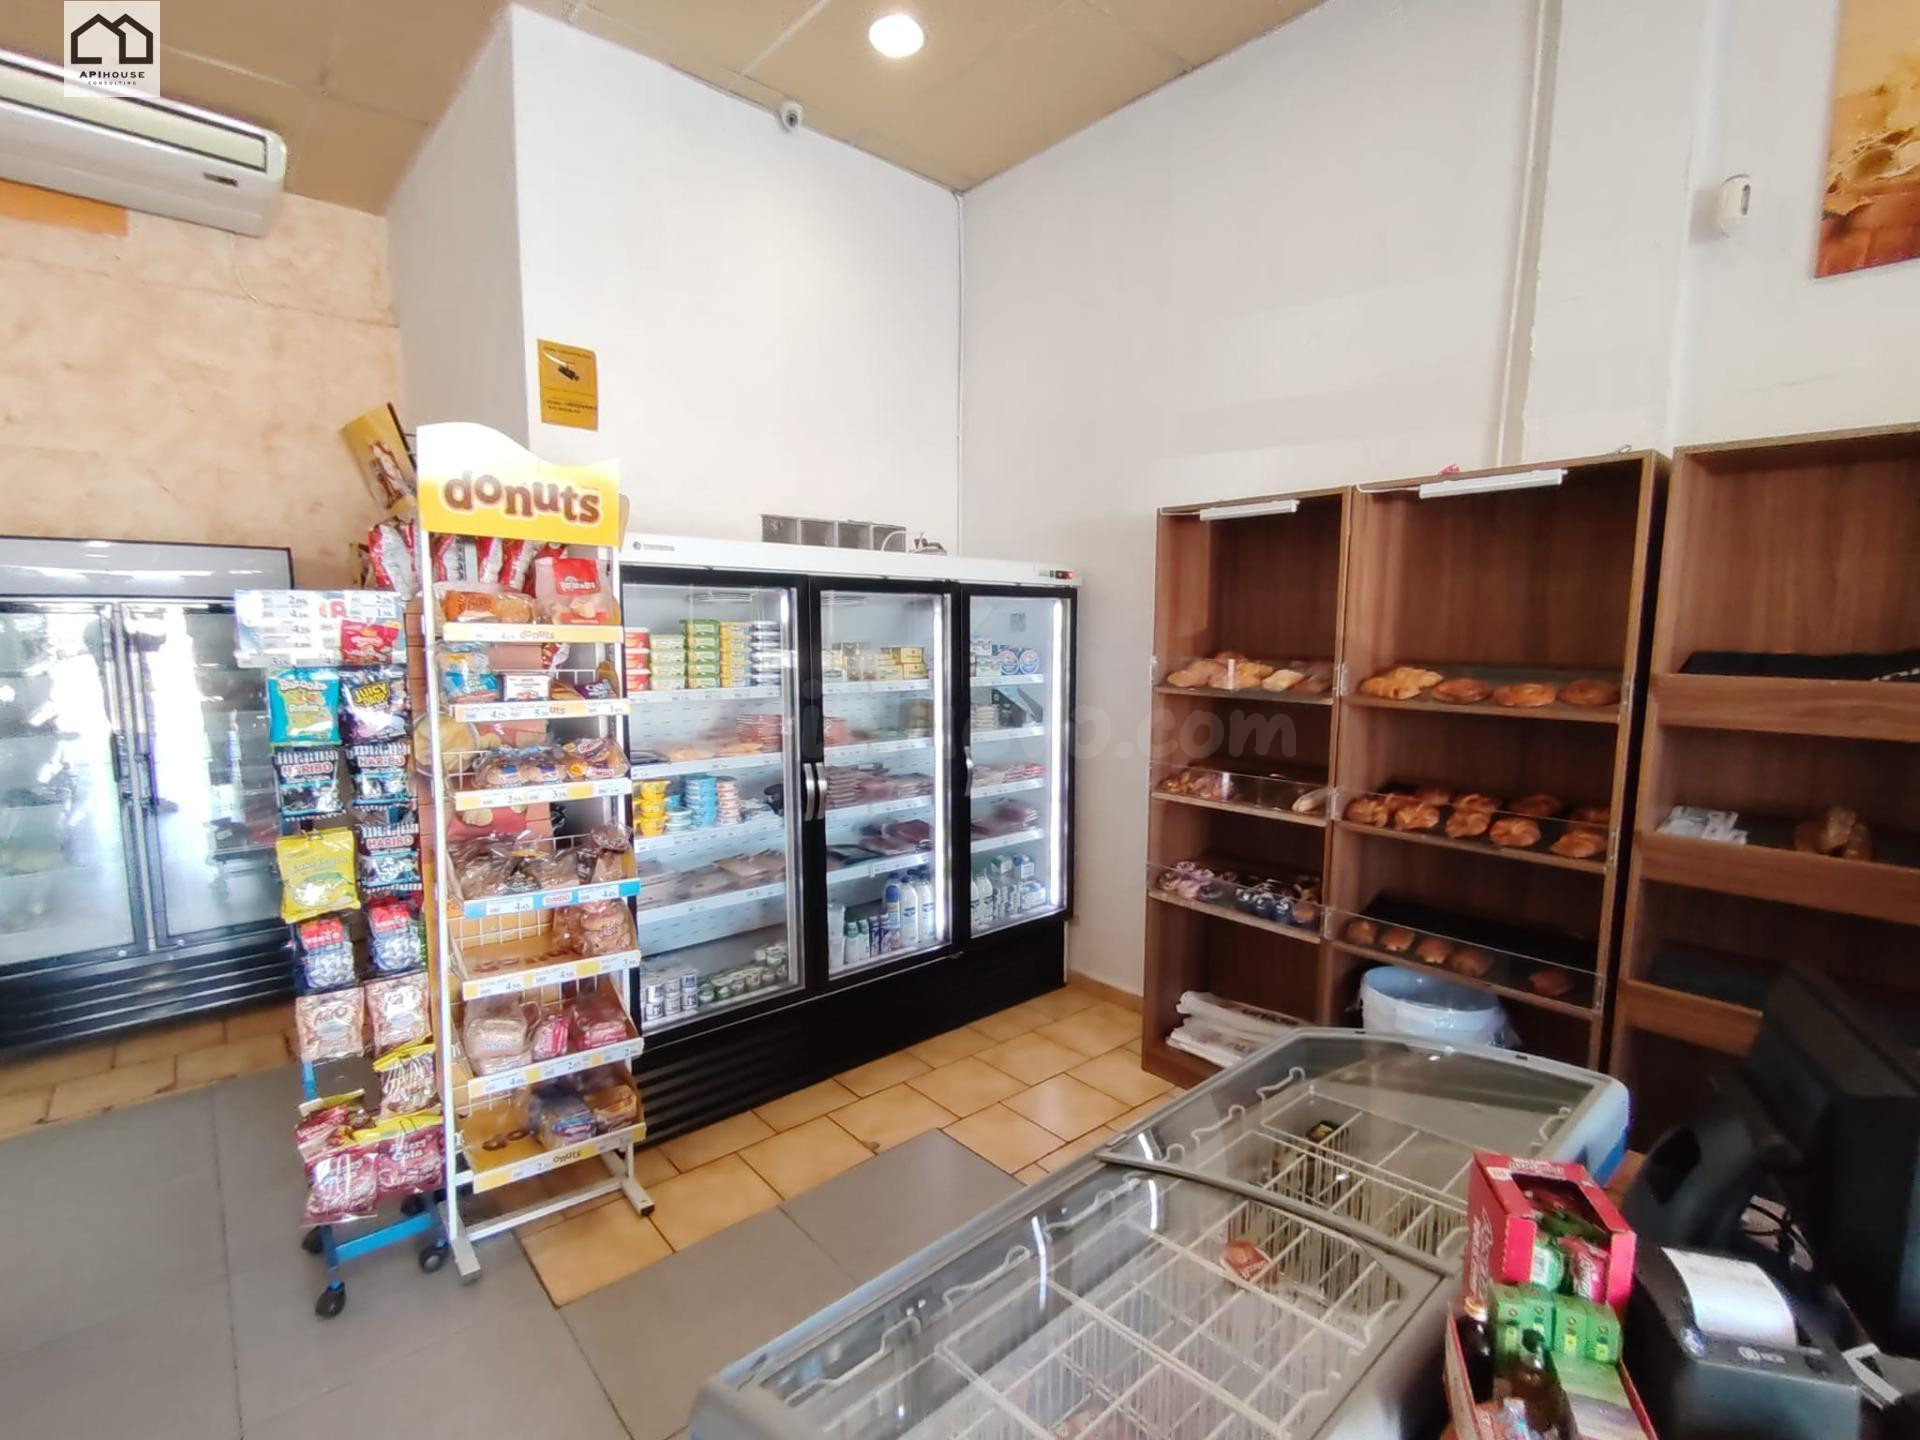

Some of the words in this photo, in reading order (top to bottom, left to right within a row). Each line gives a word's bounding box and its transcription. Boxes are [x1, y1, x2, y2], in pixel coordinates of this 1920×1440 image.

[444, 470, 600, 524] donuts
[353, 682, 388, 703] JUICY
[367, 836, 414, 848] HARIBO
